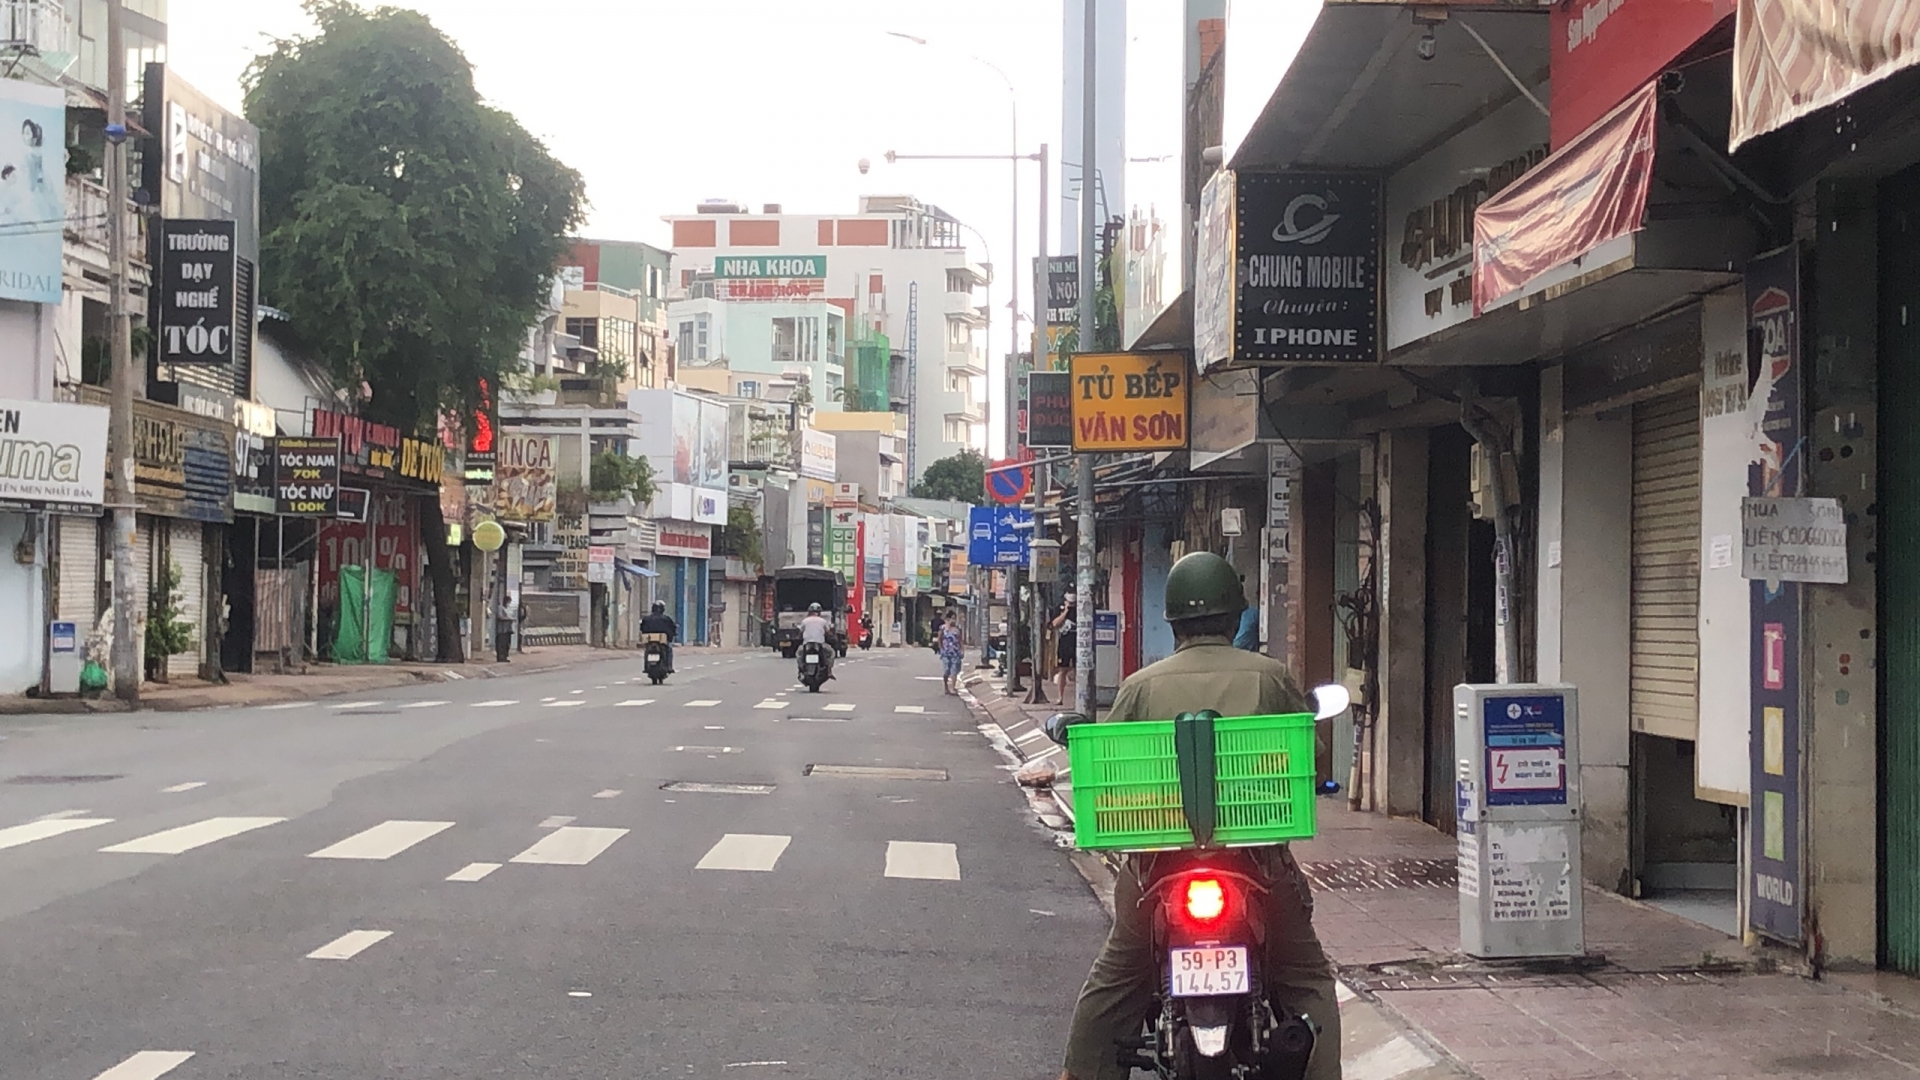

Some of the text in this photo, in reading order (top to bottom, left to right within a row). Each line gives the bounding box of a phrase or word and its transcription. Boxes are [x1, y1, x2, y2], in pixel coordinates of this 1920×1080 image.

[168, 229, 229, 251] TRƯỜNG
[182, 263, 213, 282] DẠY
[724, 259, 816, 276] NHA KHOA
[1250, 254, 1365, 288] CHUNG MOBILE
[165, 317, 229, 354] TÓC
[1078, 364, 1115, 400] TỦ
[1124, 361, 1180, 399] BẾP
[1079, 411, 1127, 442] VĂN
[1133, 410, 1182, 441] SƠN
[280, 452, 335, 467] TÓC NAM
[293, 469, 320, 479] 70K
[280, 483, 334, 499] TÓC NỮ
[290, 502, 326, 512] 100K
[1747, 504, 1778, 517] MUA
[558, 516, 582, 530] OFFICE
[566, 534, 589, 549] LEASE
[1757, 873, 1793, 907] WORLD
[1181, 949, 1237, 971] 59-P3
[1175, 971, 1245, 994] 144.57
